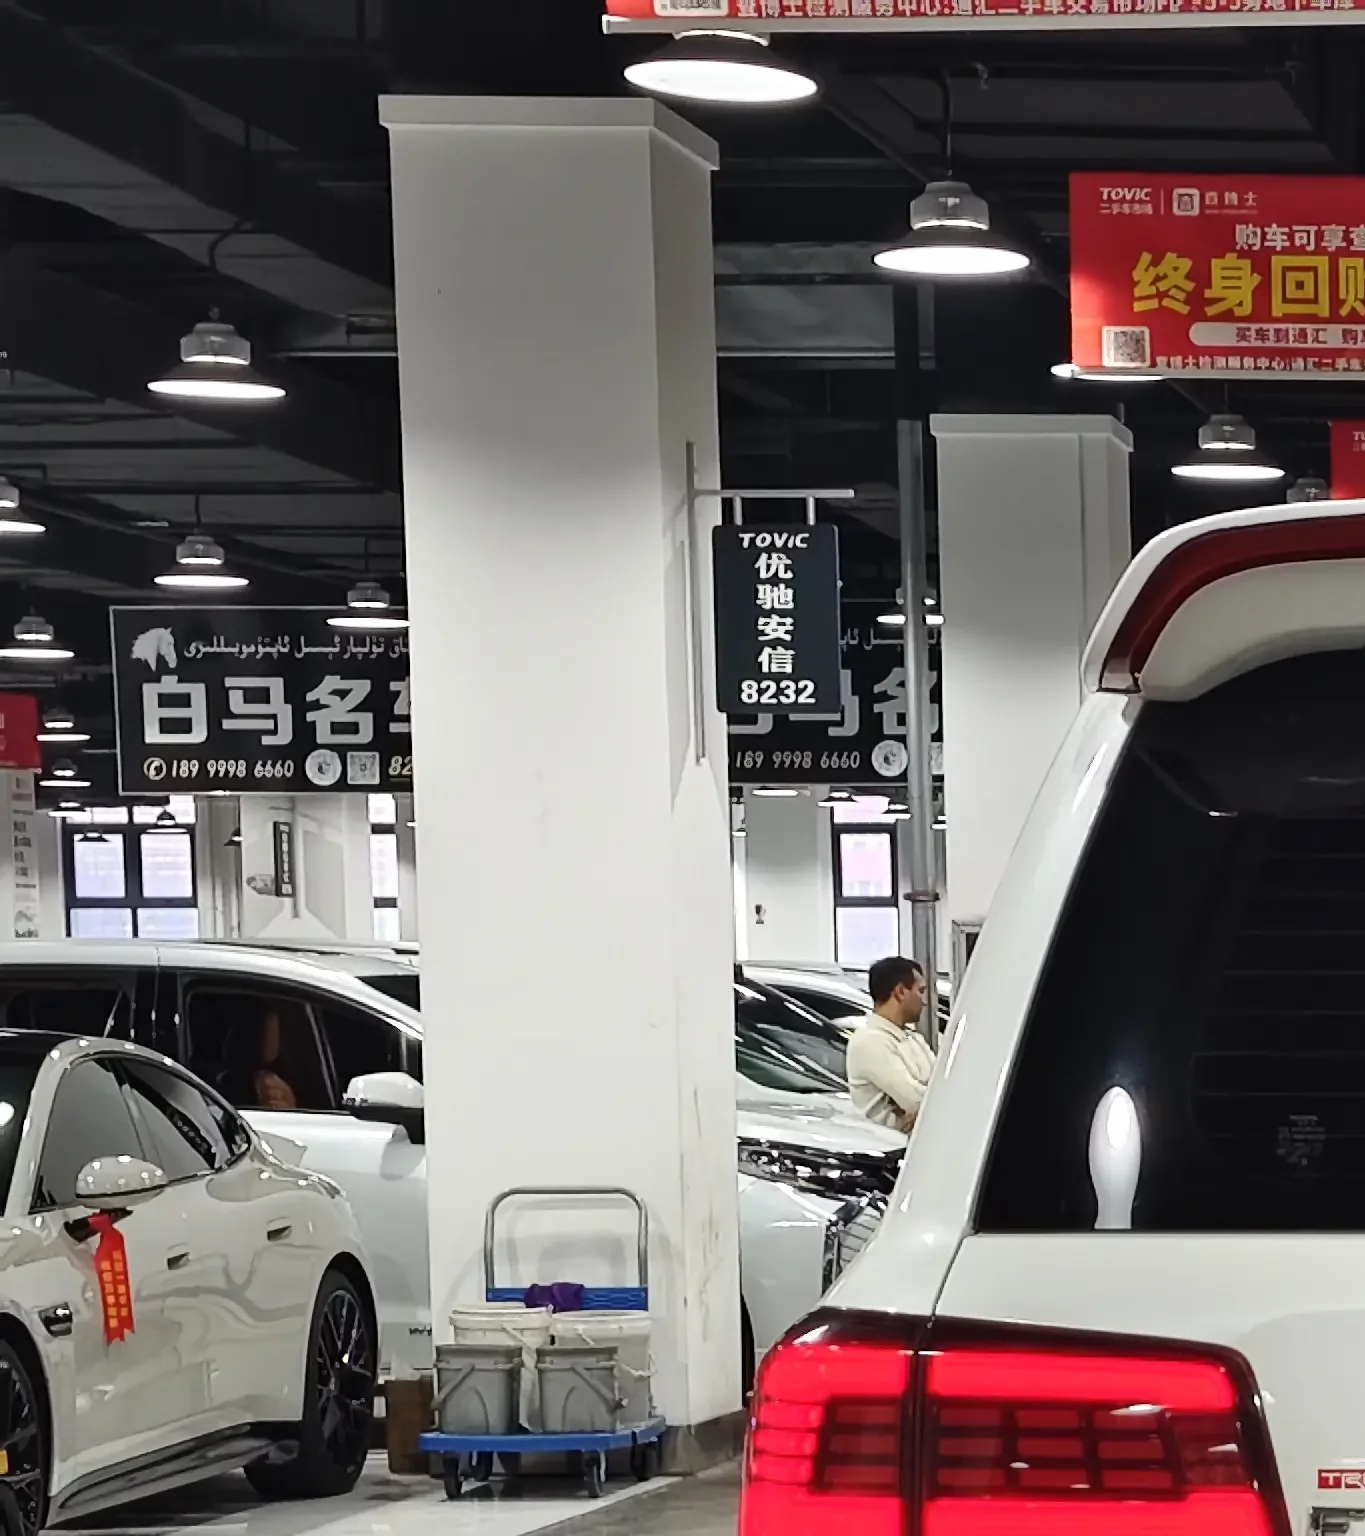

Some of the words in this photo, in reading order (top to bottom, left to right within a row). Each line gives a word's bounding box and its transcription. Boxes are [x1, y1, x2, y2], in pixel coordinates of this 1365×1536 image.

[1100, 187, 1153, 201] TOVIC
[1235, 326, 1328, 346] 买车到通汇
[738, 532, 810, 549] TOVIC
[754, 551, 796, 675] 优驰安信
[740, 679, 816, 705] 8232
[172, 758, 199, 778] 189
[207, 758, 247, 778] 9998
[253, 758, 295, 778] 6660
[736, 751, 763, 768] 189
[772, 751, 812, 769] 9998
[820, 751, 861, 769] 6660
